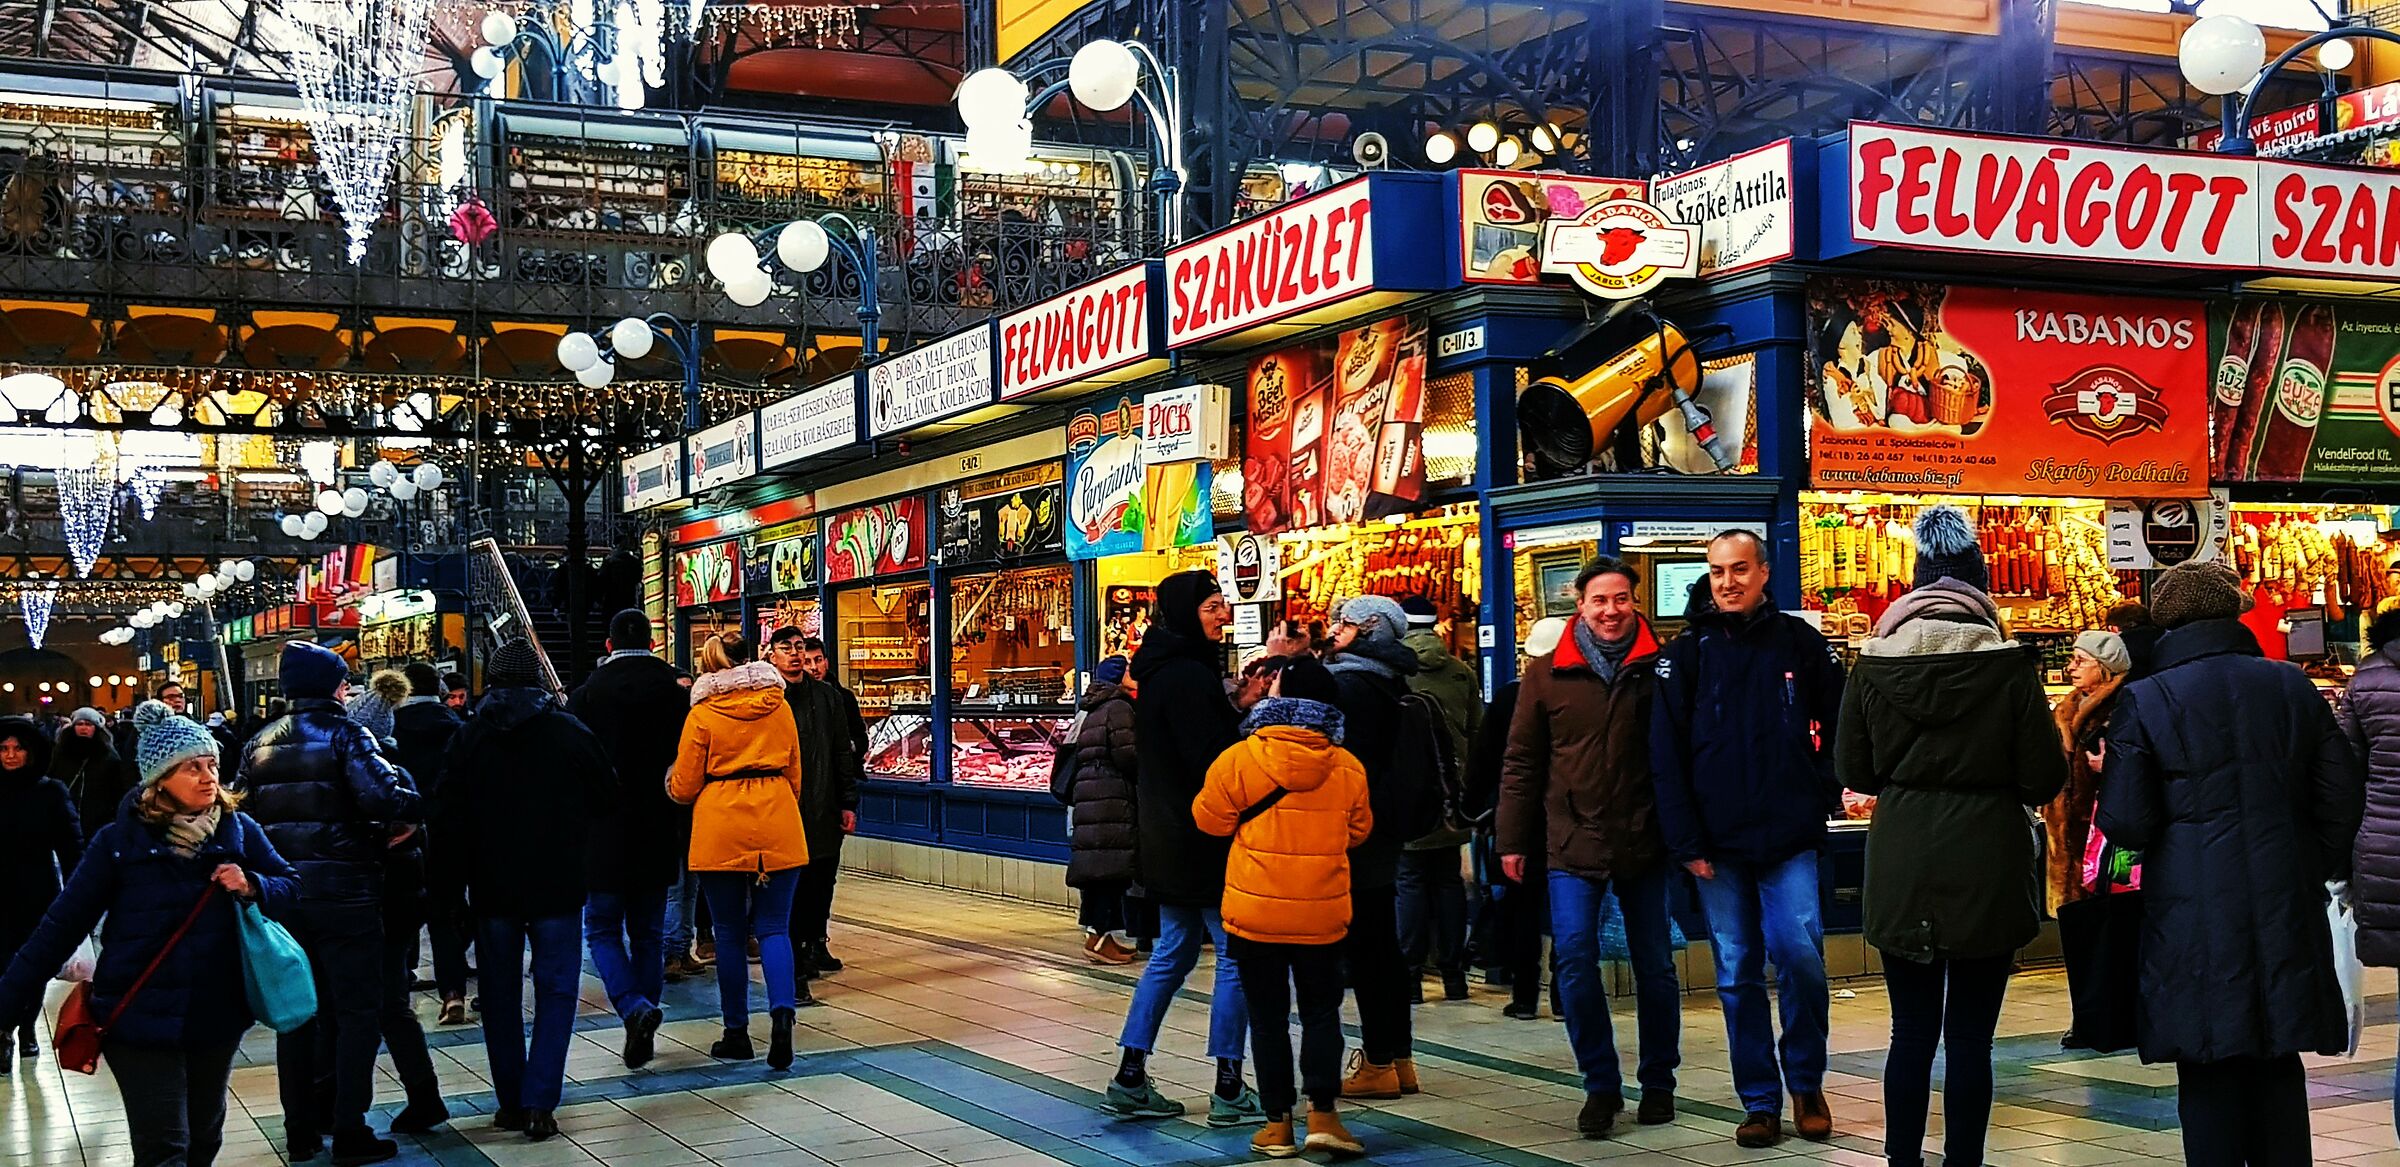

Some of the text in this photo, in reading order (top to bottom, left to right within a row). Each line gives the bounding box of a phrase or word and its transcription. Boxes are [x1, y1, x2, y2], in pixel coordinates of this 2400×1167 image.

[2274, 103, 2316, 137] ÜDÍTŐ
[2255, 130, 2316, 156] LACSINTA
[1656, 177, 1707, 203] Tulajdonos:
[1676, 170, 1787, 223] Szőke Attila
[1858, 138, 2248, 255] FELVÁGOTT
[1172, 199, 1372, 335] SZAKÜZLET
[1004, 280, 1147, 389] FELVÁGOTT
[2014, 310, 2195, 350] KABANOS
[925, 330, 988, 370] MALACHUSOK
[1258, 375, 1284, 409] Beef
[1149, 402, 1193, 439] PICK
[1252, 396, 1287, 433] Master
[1856, 452, 1870, 460] 26
[1872, 452, 1885, 461] 40
[1950, 455, 1963, 464] 26
[1964, 456, 1977, 464] 40
[1978, 457, 1997, 465] 468
[2317, 447, 2375, 460] VendelFood
[1819, 466, 1964, 489] www.kabanos.biz.pl
[2026, 457, 2190, 487] Skarby Podhala
